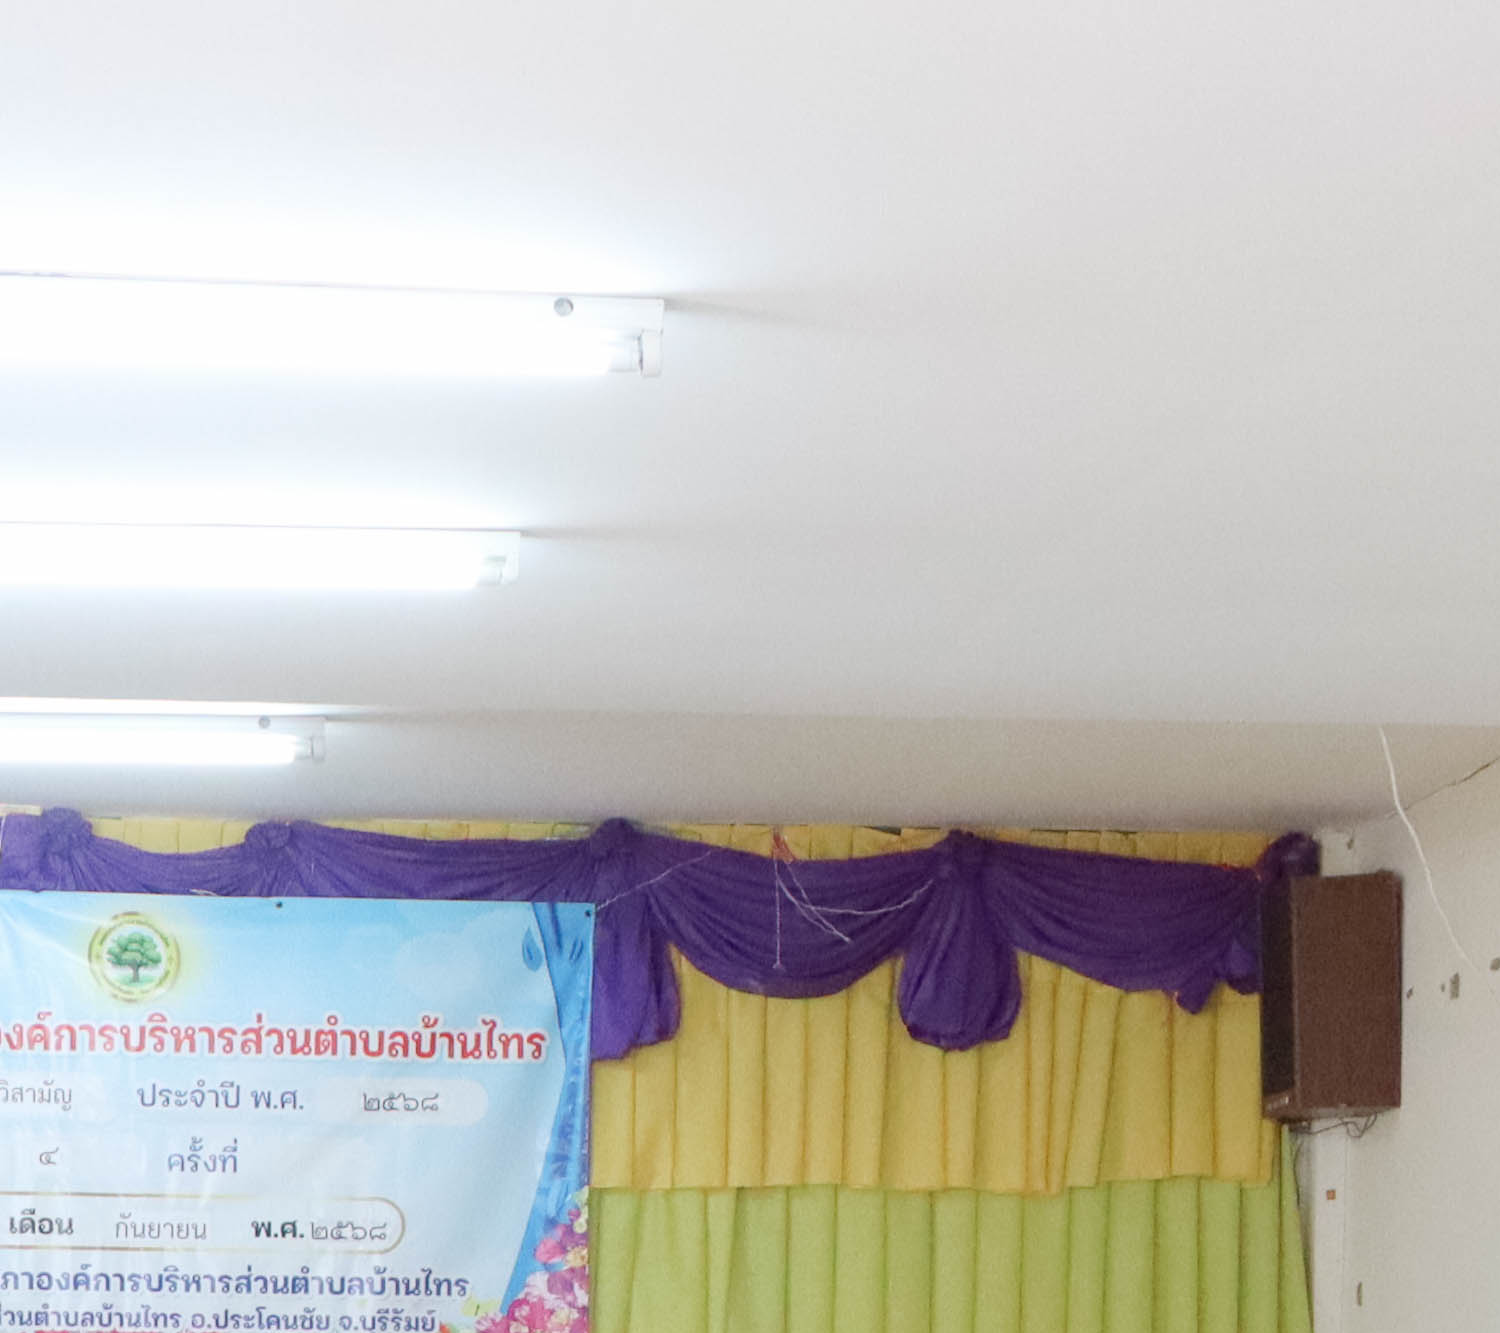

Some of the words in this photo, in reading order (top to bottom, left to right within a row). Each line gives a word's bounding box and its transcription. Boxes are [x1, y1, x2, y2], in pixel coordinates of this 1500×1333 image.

[137, 1080, 240, 1110] ประจำปี
[251, 1086, 304, 1111] พ.ศ.
[362, 1091, 440, 1112] ๒๕๖๘
[168, 1136, 238, 1173] ครั้งที่
[9, 1209, 74, 1236] เดือน
[115, 1212, 207, 1240] กันยายน
[251, 1219, 304, 1239] พ.ศ.
[311, 1220, 387, 1242] ๒๕๖๘
[190, 1304, 331, 1332] อ.ประโคนชัย
